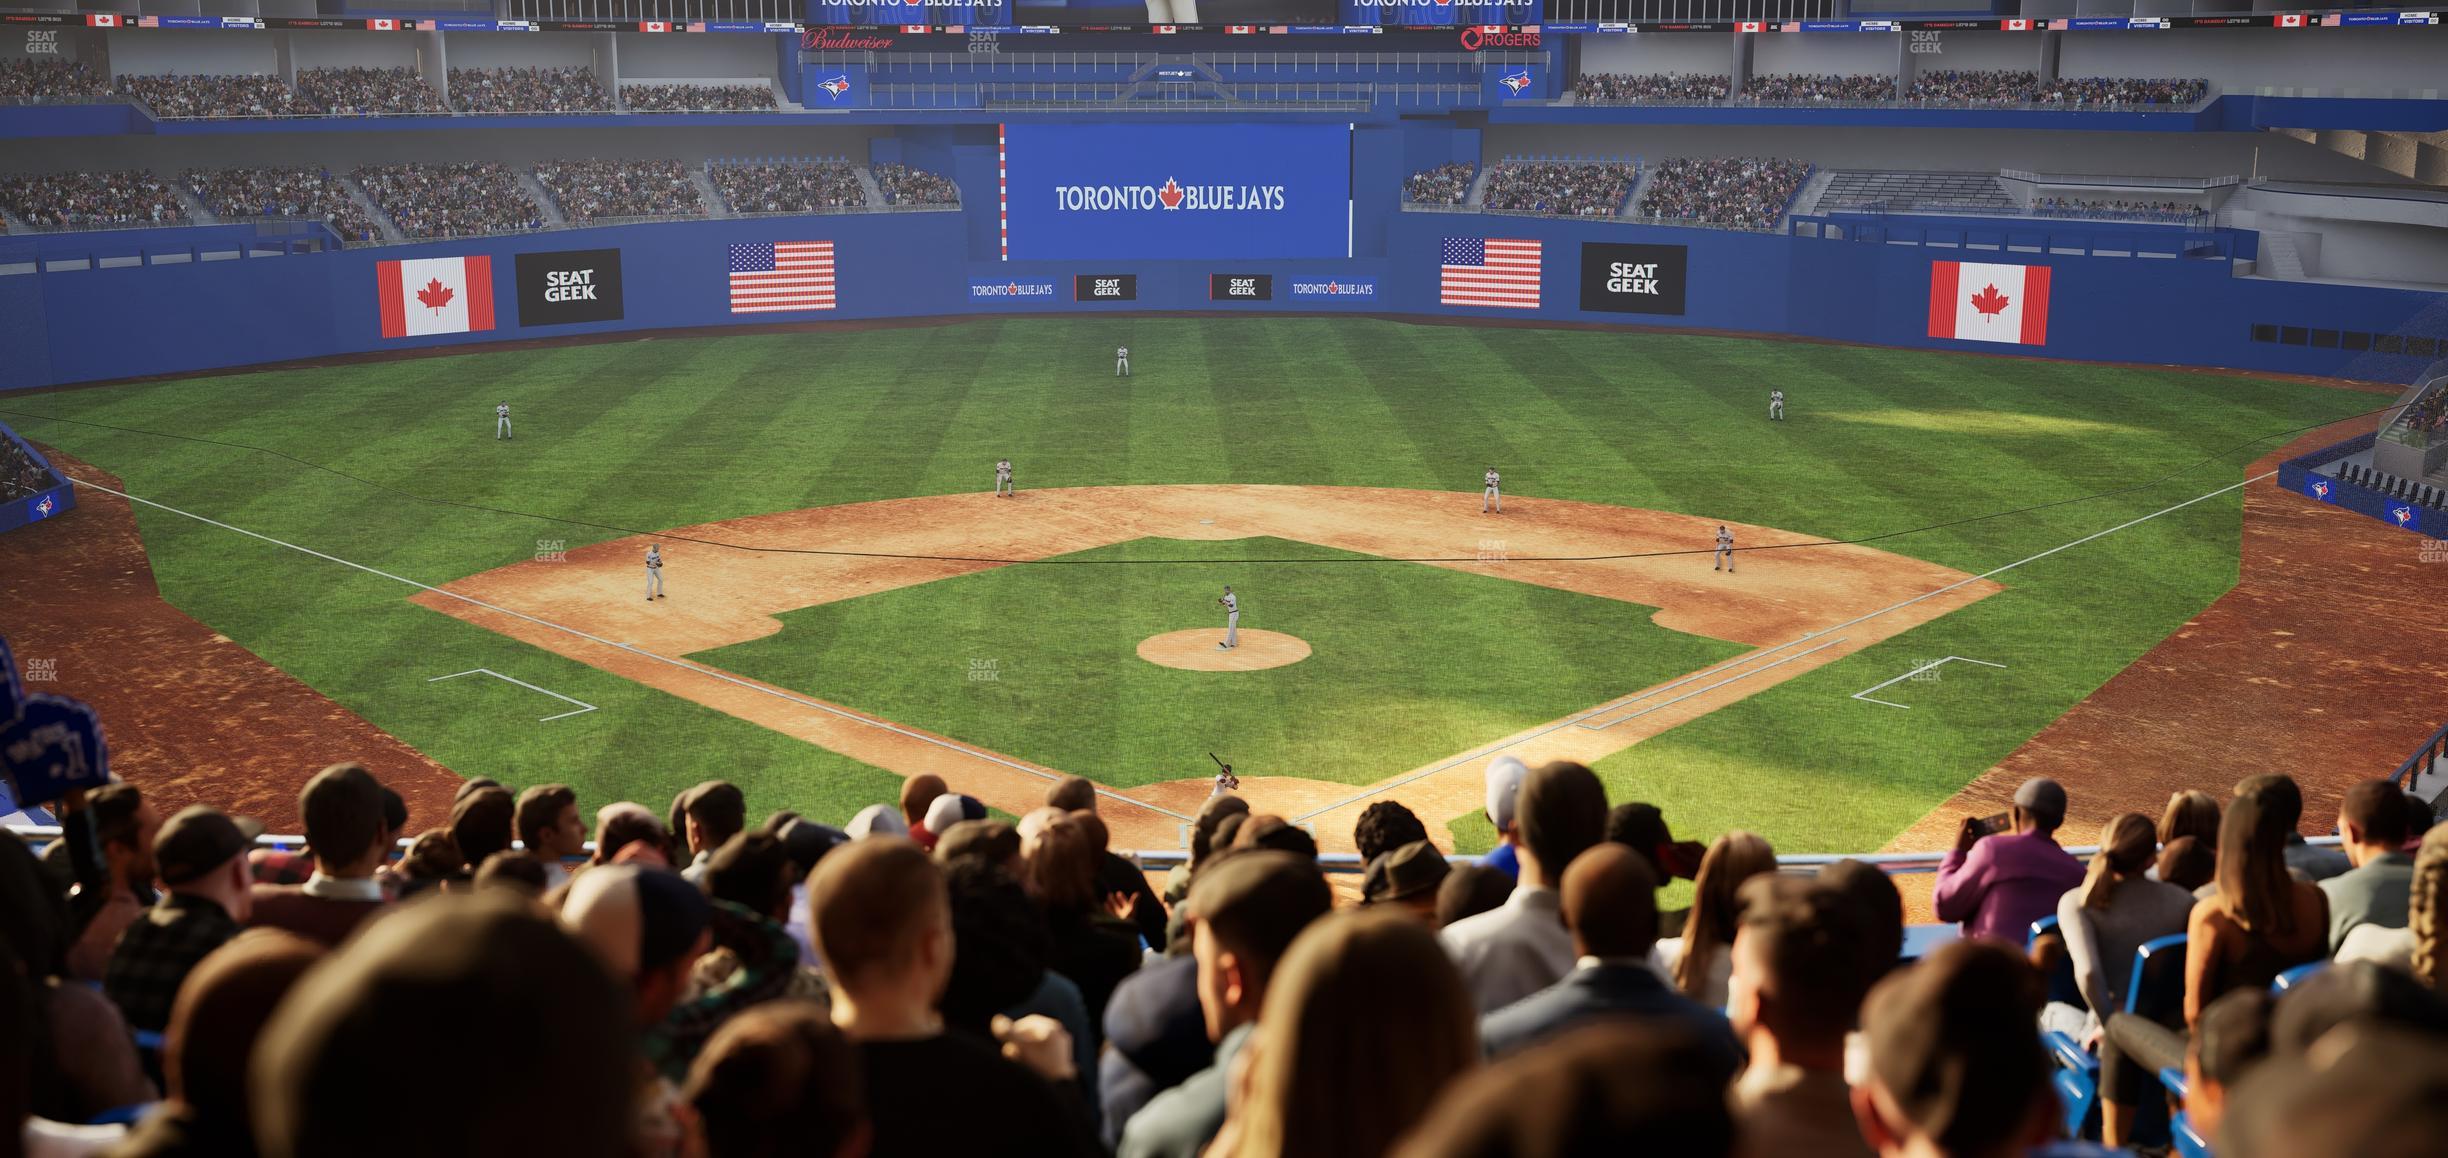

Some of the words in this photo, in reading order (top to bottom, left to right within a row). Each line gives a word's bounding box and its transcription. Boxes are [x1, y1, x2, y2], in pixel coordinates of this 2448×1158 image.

[801, 27, 894, 50] Budweiser
[1484, 33, 1540, 47] ROGERS
[1056, 185, 1156, 210] TORONTO
[1186, 186, 1234, 210] BLUE
[1237, 185, 1284, 210] JAYS
[1610, 262, 1658, 278] SEAT
[547, 269, 593, 287] SEAT
[1095, 279, 1119, 288] SEAT
[1230, 278, 1255, 287] SEAT
[545, 285, 597, 302] GEEK
[972, 285, 1007, 296] TORONTO
[1017, 285, 1035, 295] BLUE
[1035, 284, 1052, 295] JAYS
[1094, 287, 1121, 296] GEEK
[1229, 287, 1256, 295] GEEK
[1293, 283, 1328, 294] TORONTO
[1338, 284, 1356, 295] BLUE
[1356, 285, 1373, 295] JAYS
[1606, 278, 1658, 295] GEEK
